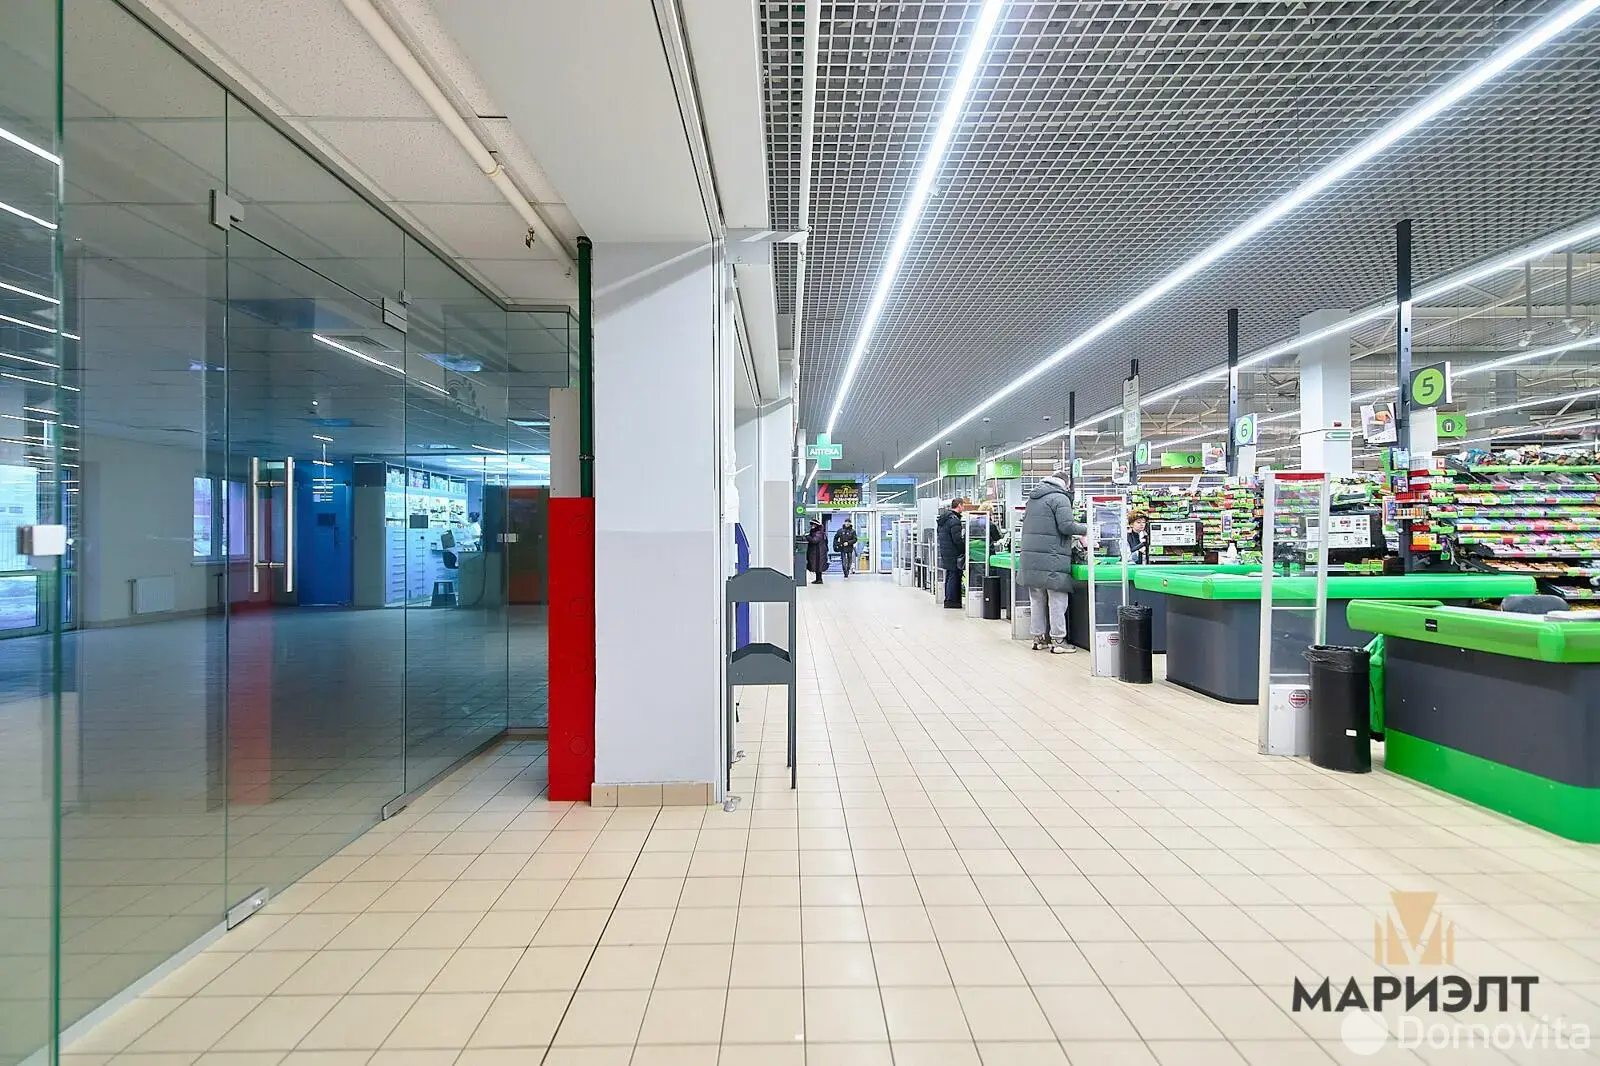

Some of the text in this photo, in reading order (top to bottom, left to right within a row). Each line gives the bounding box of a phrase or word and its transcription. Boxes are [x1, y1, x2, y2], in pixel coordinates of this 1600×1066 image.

[1422, 376, 1434, 397] 5
[1241, 423, 1248, 438] 6
[1140, 448, 1145, 459] 7
